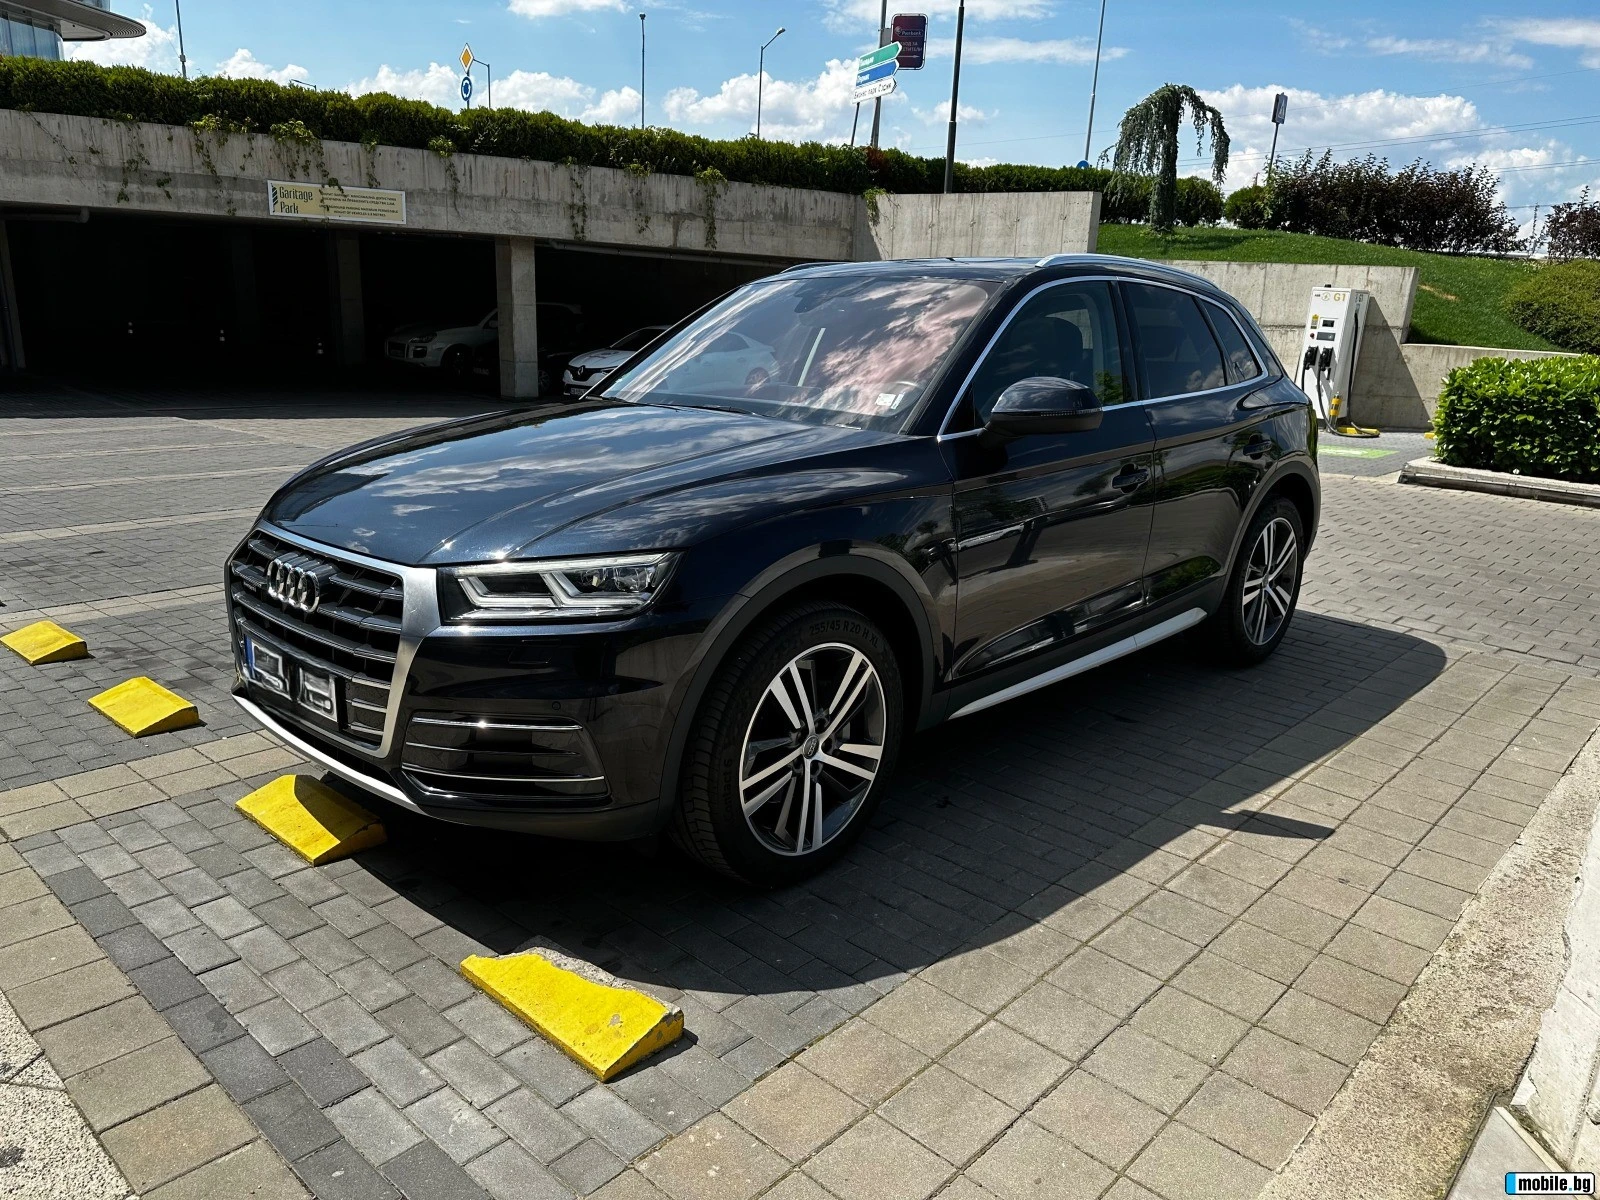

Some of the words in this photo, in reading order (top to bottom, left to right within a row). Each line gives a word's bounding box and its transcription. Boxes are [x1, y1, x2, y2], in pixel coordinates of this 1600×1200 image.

[279, 187, 313, 203] Garitage
[280, 202, 299, 214] Park
[1334, 292, 1346, 302] G1
[809, 620, 841, 636] 255/45
[862, 627, 870, 640] H
[869, 632, 879, 648] XL
